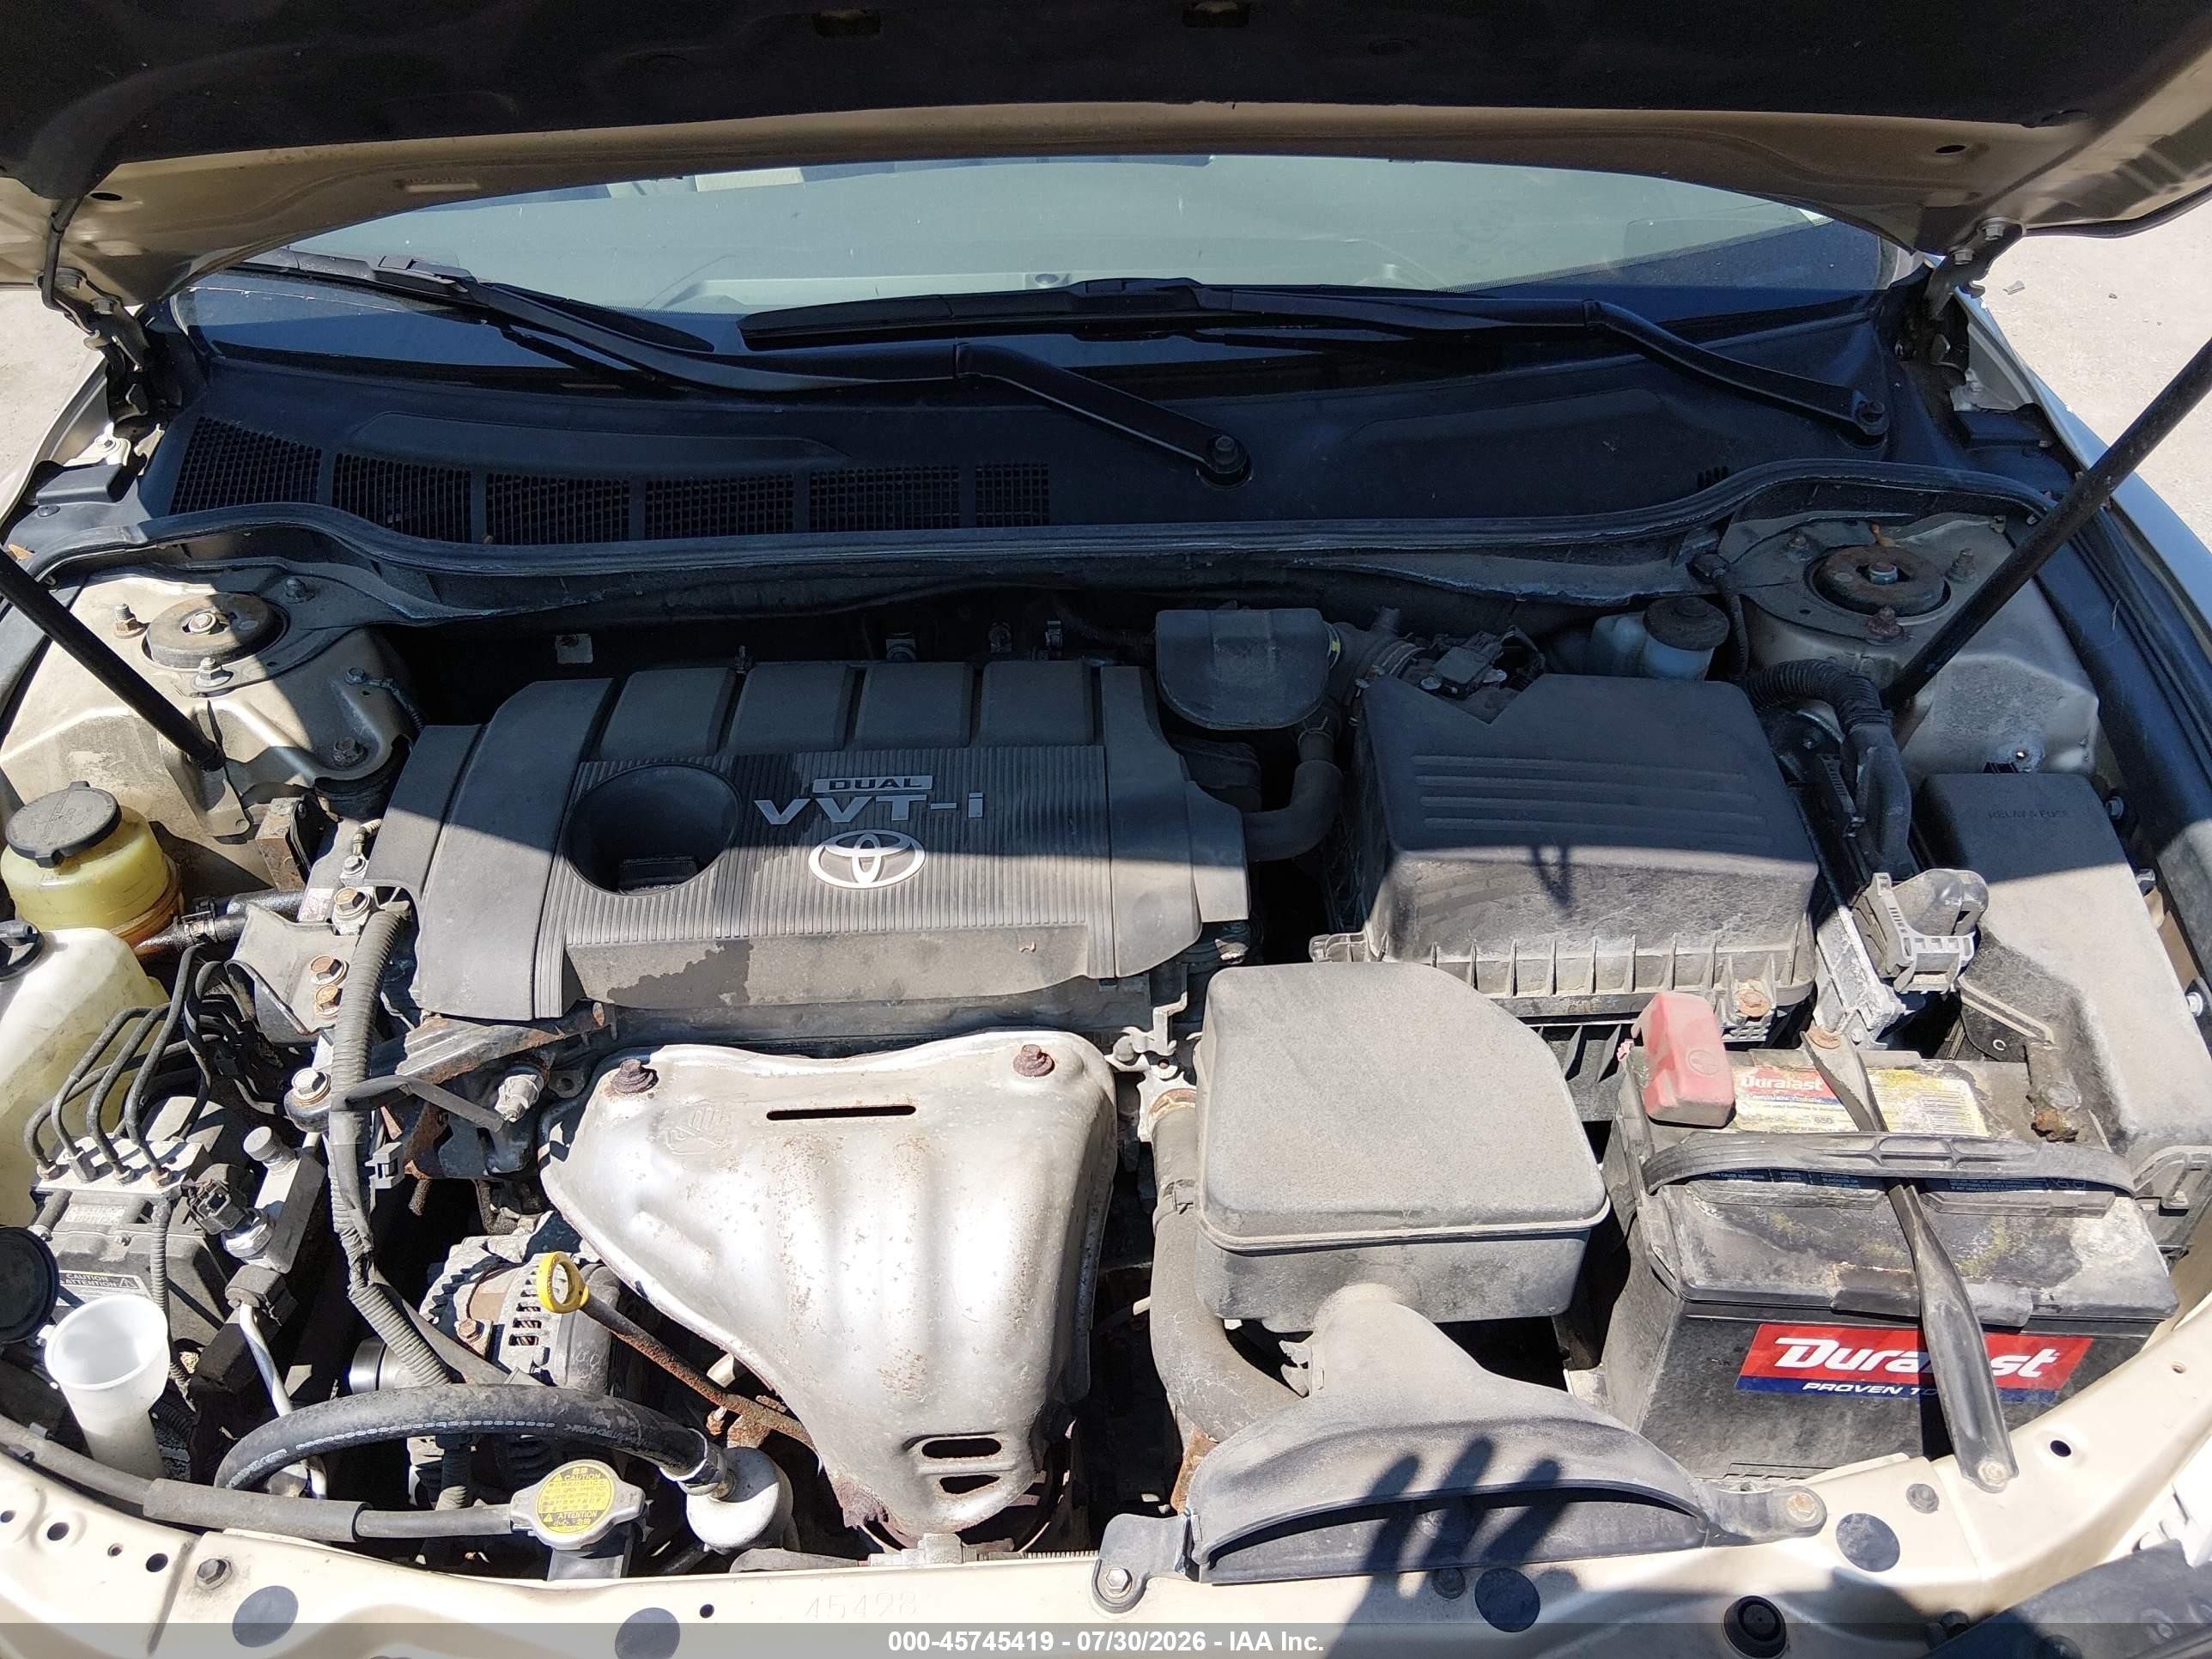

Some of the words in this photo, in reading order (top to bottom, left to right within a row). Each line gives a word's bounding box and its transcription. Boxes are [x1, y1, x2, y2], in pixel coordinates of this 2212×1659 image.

[828, 777, 923, 791] DUAL
[753, 792, 984, 825] VVT-i
[65, 1279, 118, 1287] ATTENTION
[66, 1273, 109, 1282] CAUTION
[1774, 1337, 2061, 1378] Durast
[1802, 1382, 1903, 1395] PROVEN
[564, 1473, 601, 1481] CAUTION
[557, 1510, 598, 1520] ATTENTION
